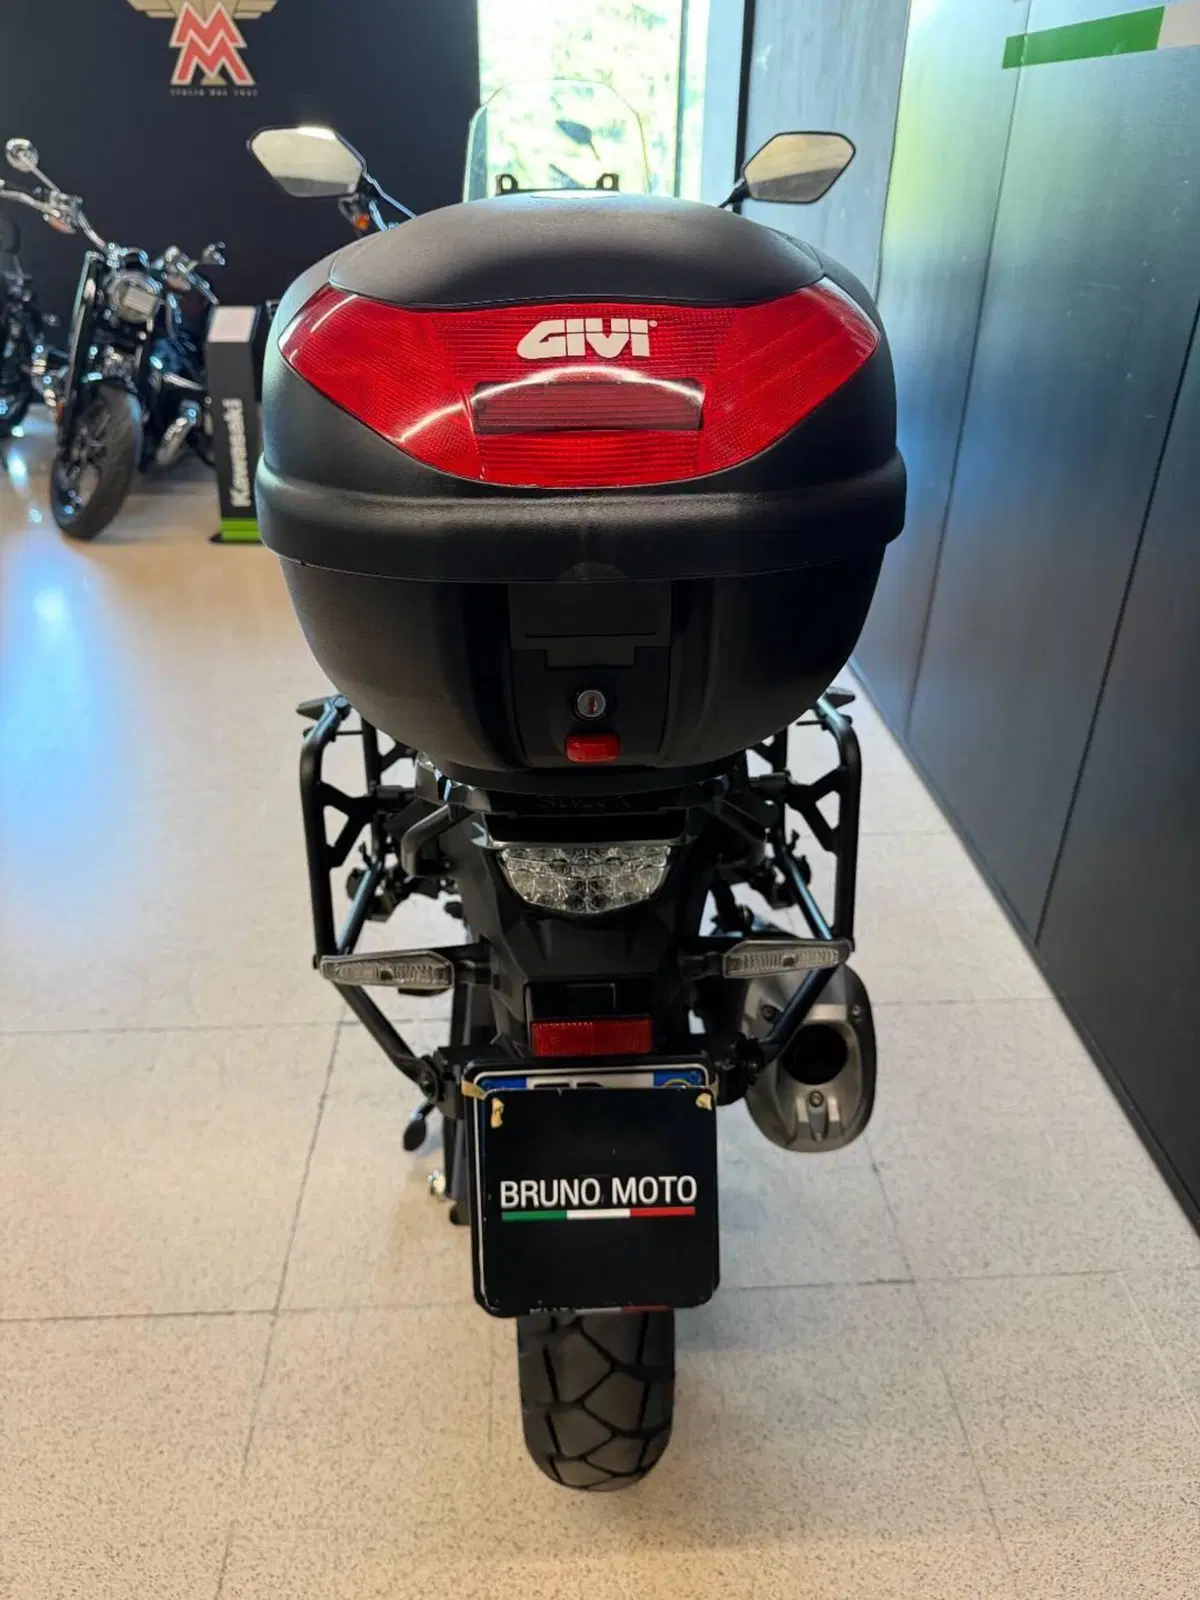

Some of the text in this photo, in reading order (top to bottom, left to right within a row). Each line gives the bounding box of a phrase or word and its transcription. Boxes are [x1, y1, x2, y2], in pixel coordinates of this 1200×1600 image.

[516, 317, 651, 360] GIVI
[499, 1174, 698, 1209] BRUNO MOTO
